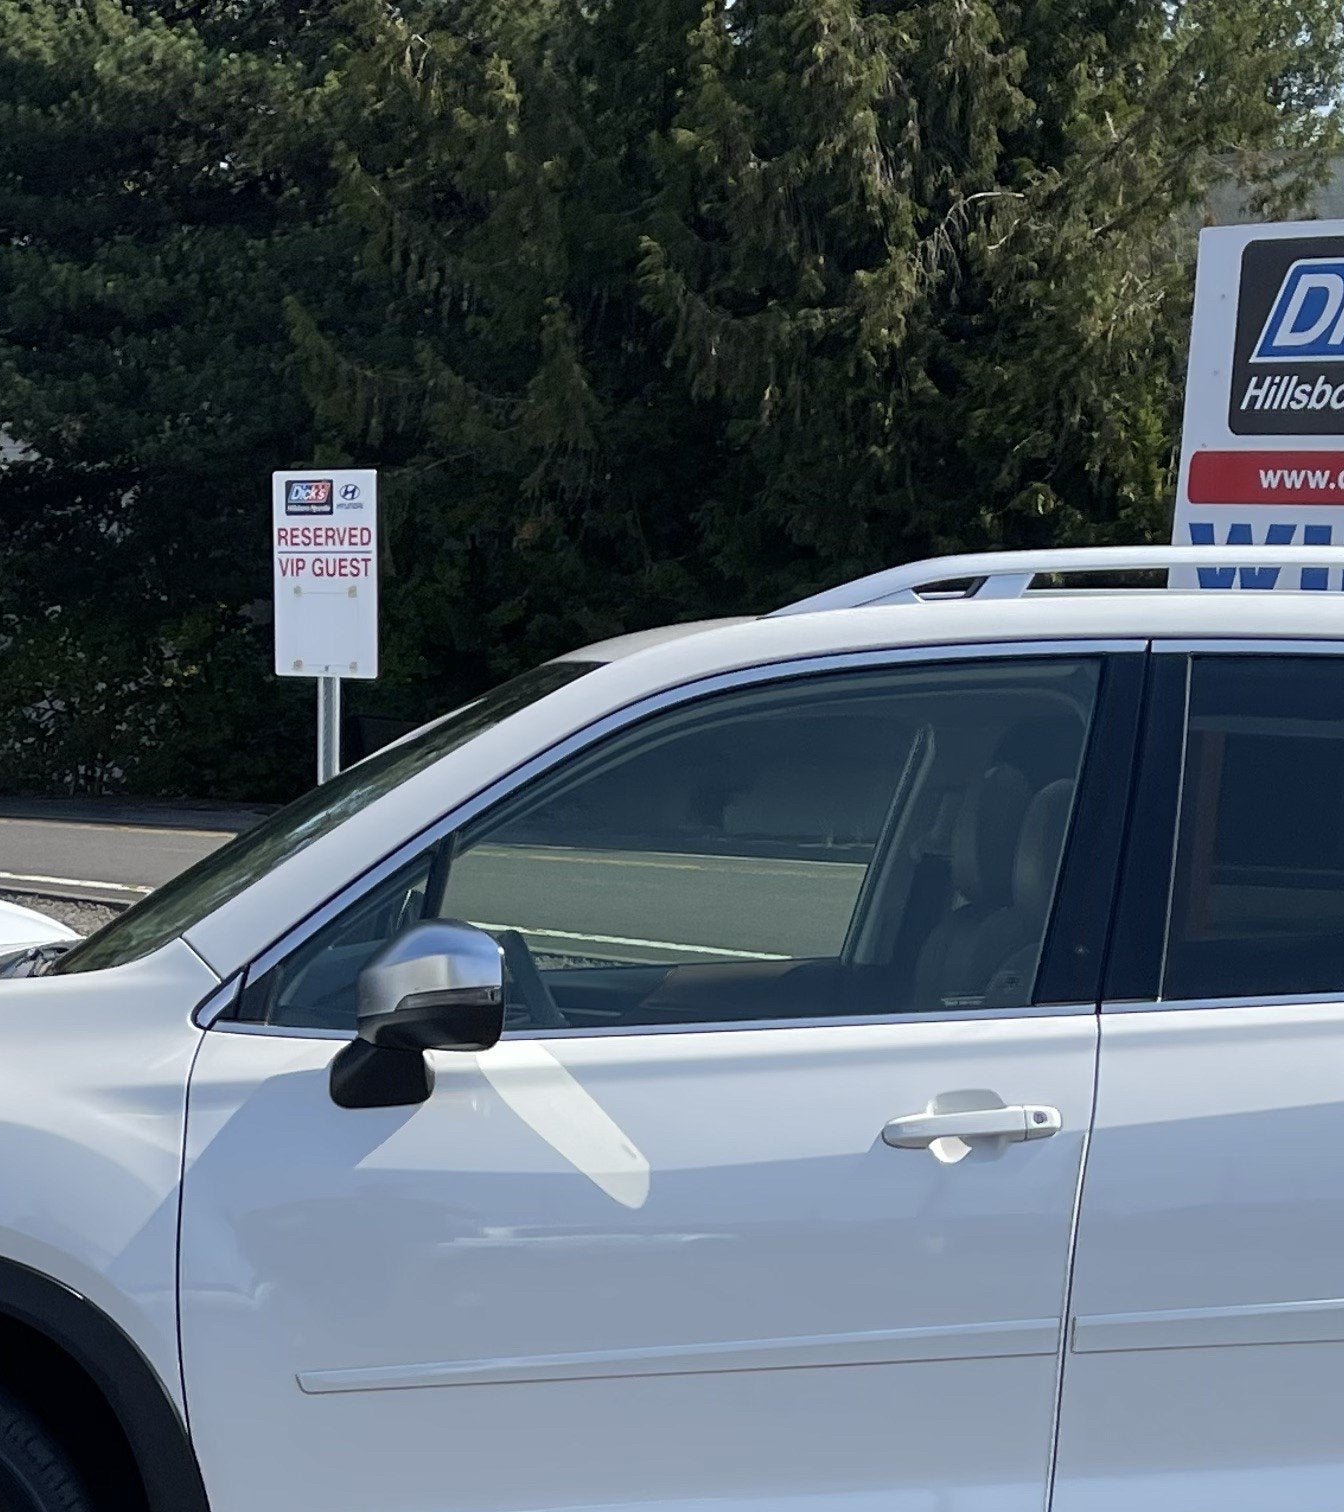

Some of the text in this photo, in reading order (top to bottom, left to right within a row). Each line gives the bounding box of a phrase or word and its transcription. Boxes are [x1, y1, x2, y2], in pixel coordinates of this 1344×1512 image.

[277, 527, 372, 547] RESERVED
[278, 558, 372, 577] VIP GUEST
